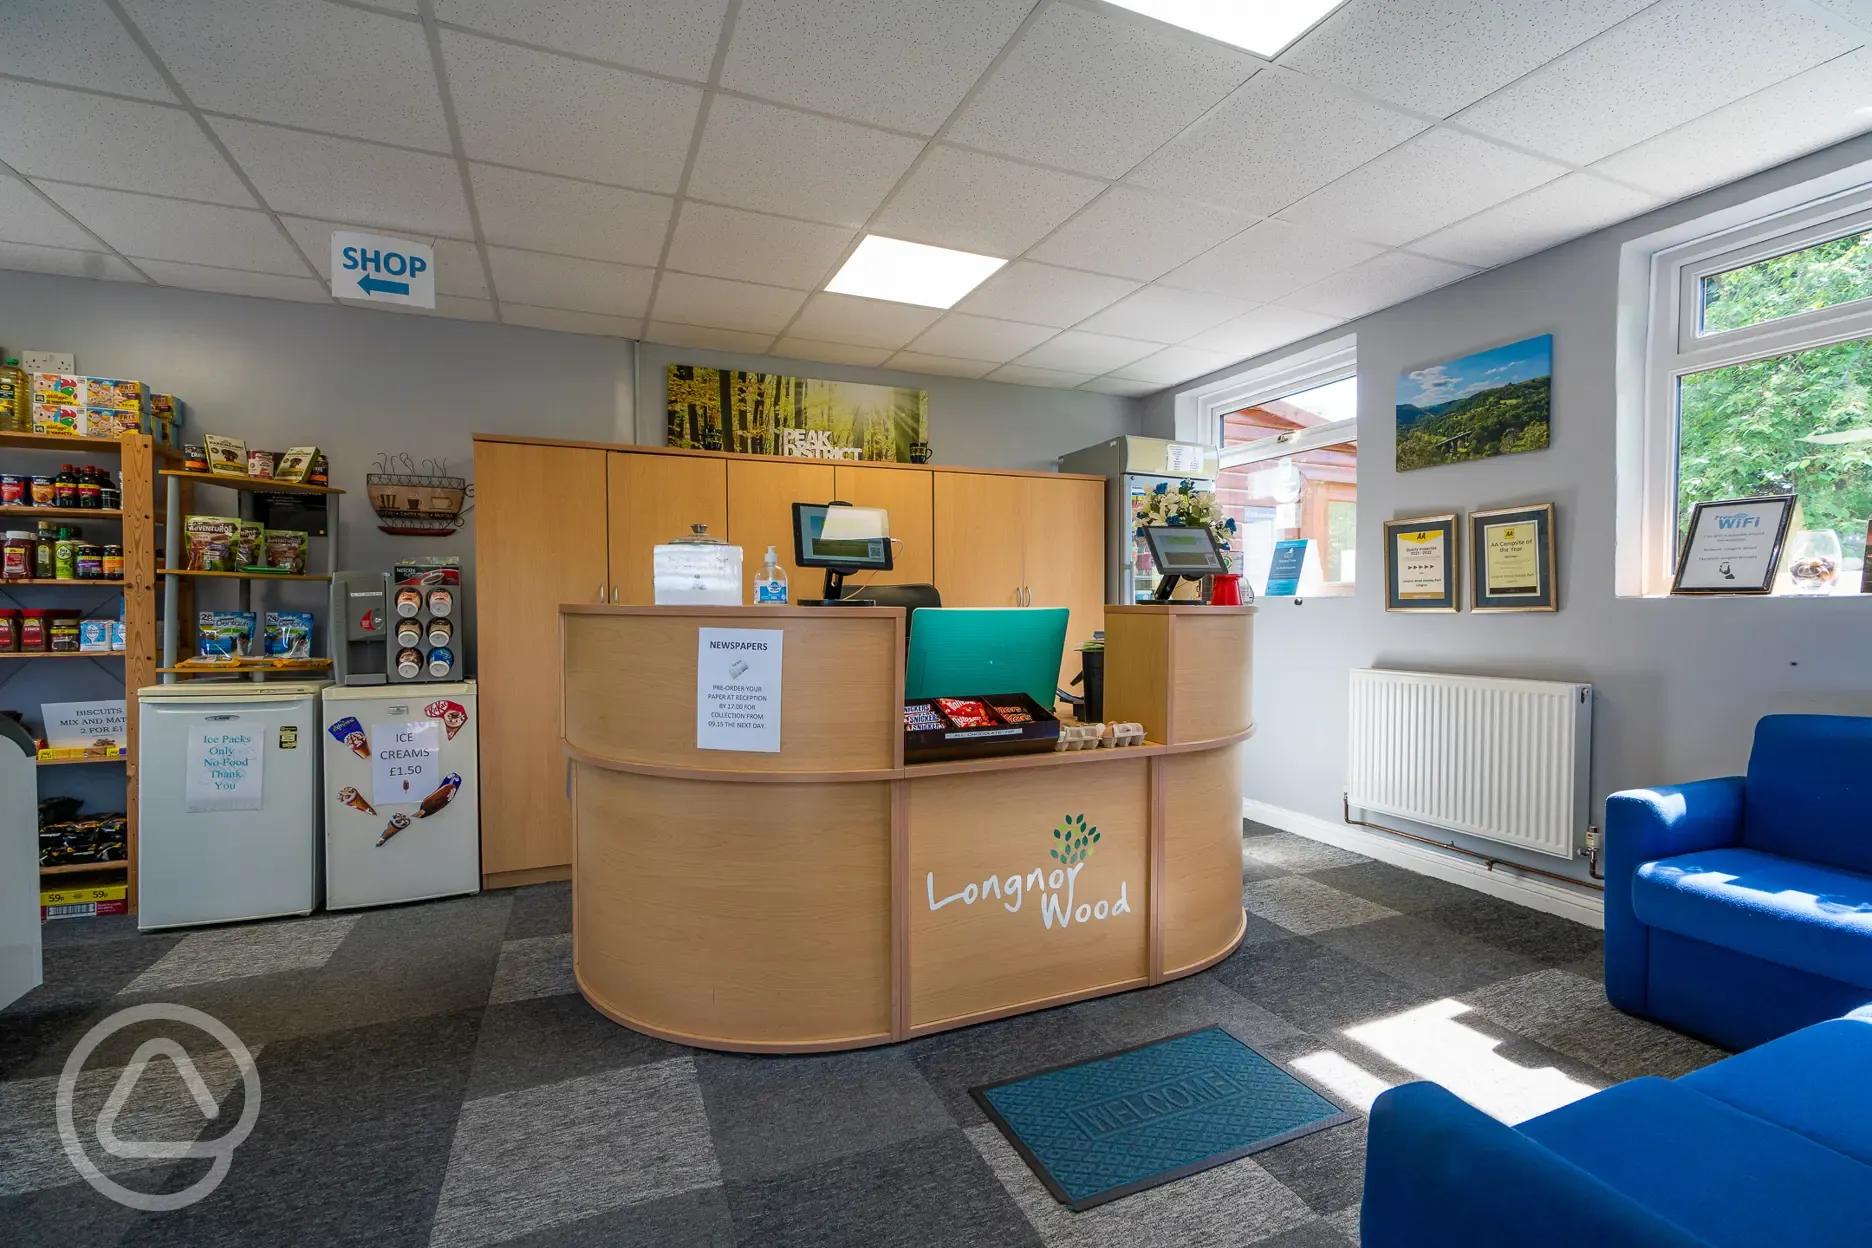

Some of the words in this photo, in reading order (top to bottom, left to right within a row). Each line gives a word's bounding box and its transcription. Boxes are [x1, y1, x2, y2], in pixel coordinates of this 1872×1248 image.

[343, 246, 427, 278] SHOP
[783, 427, 832, 446] PEAK
[783, 443, 863, 460] DISTRICT
[1417, 532, 1426, 540] AA
[709, 640, 768, 651] NEWSPAPERS
[712, 684, 745, 692] PRE-ORDER
[735, 694, 768, 702] RECEPTION
[76, 707, 123, 716] BISCUITS
[710, 711, 745, 719] COLLECTION
[746, 712, 764, 720] FROM
[707, 720, 724, 728] 09.15
[203, 735, 219, 744] Ice
[222, 734, 251, 743] Packs
[395, 732, 414, 743] ICE
[209, 746, 235, 757] Only
[380, 748, 430, 761] CREAMS
[204, 758, 220, 767] No
[222, 757, 249, 767] Food
[211, 769, 242, 779] Thank
[389, 765, 422, 777] £1.50
[214, 781, 236, 790] You
[927, 862, 1085, 913] Longnor
[48, 894, 65, 902] 59p
[92, 890, 109, 899] 59p
[1041, 881, 1131, 930] Wood
[1077, 1072, 1238, 1132] WELCOME
